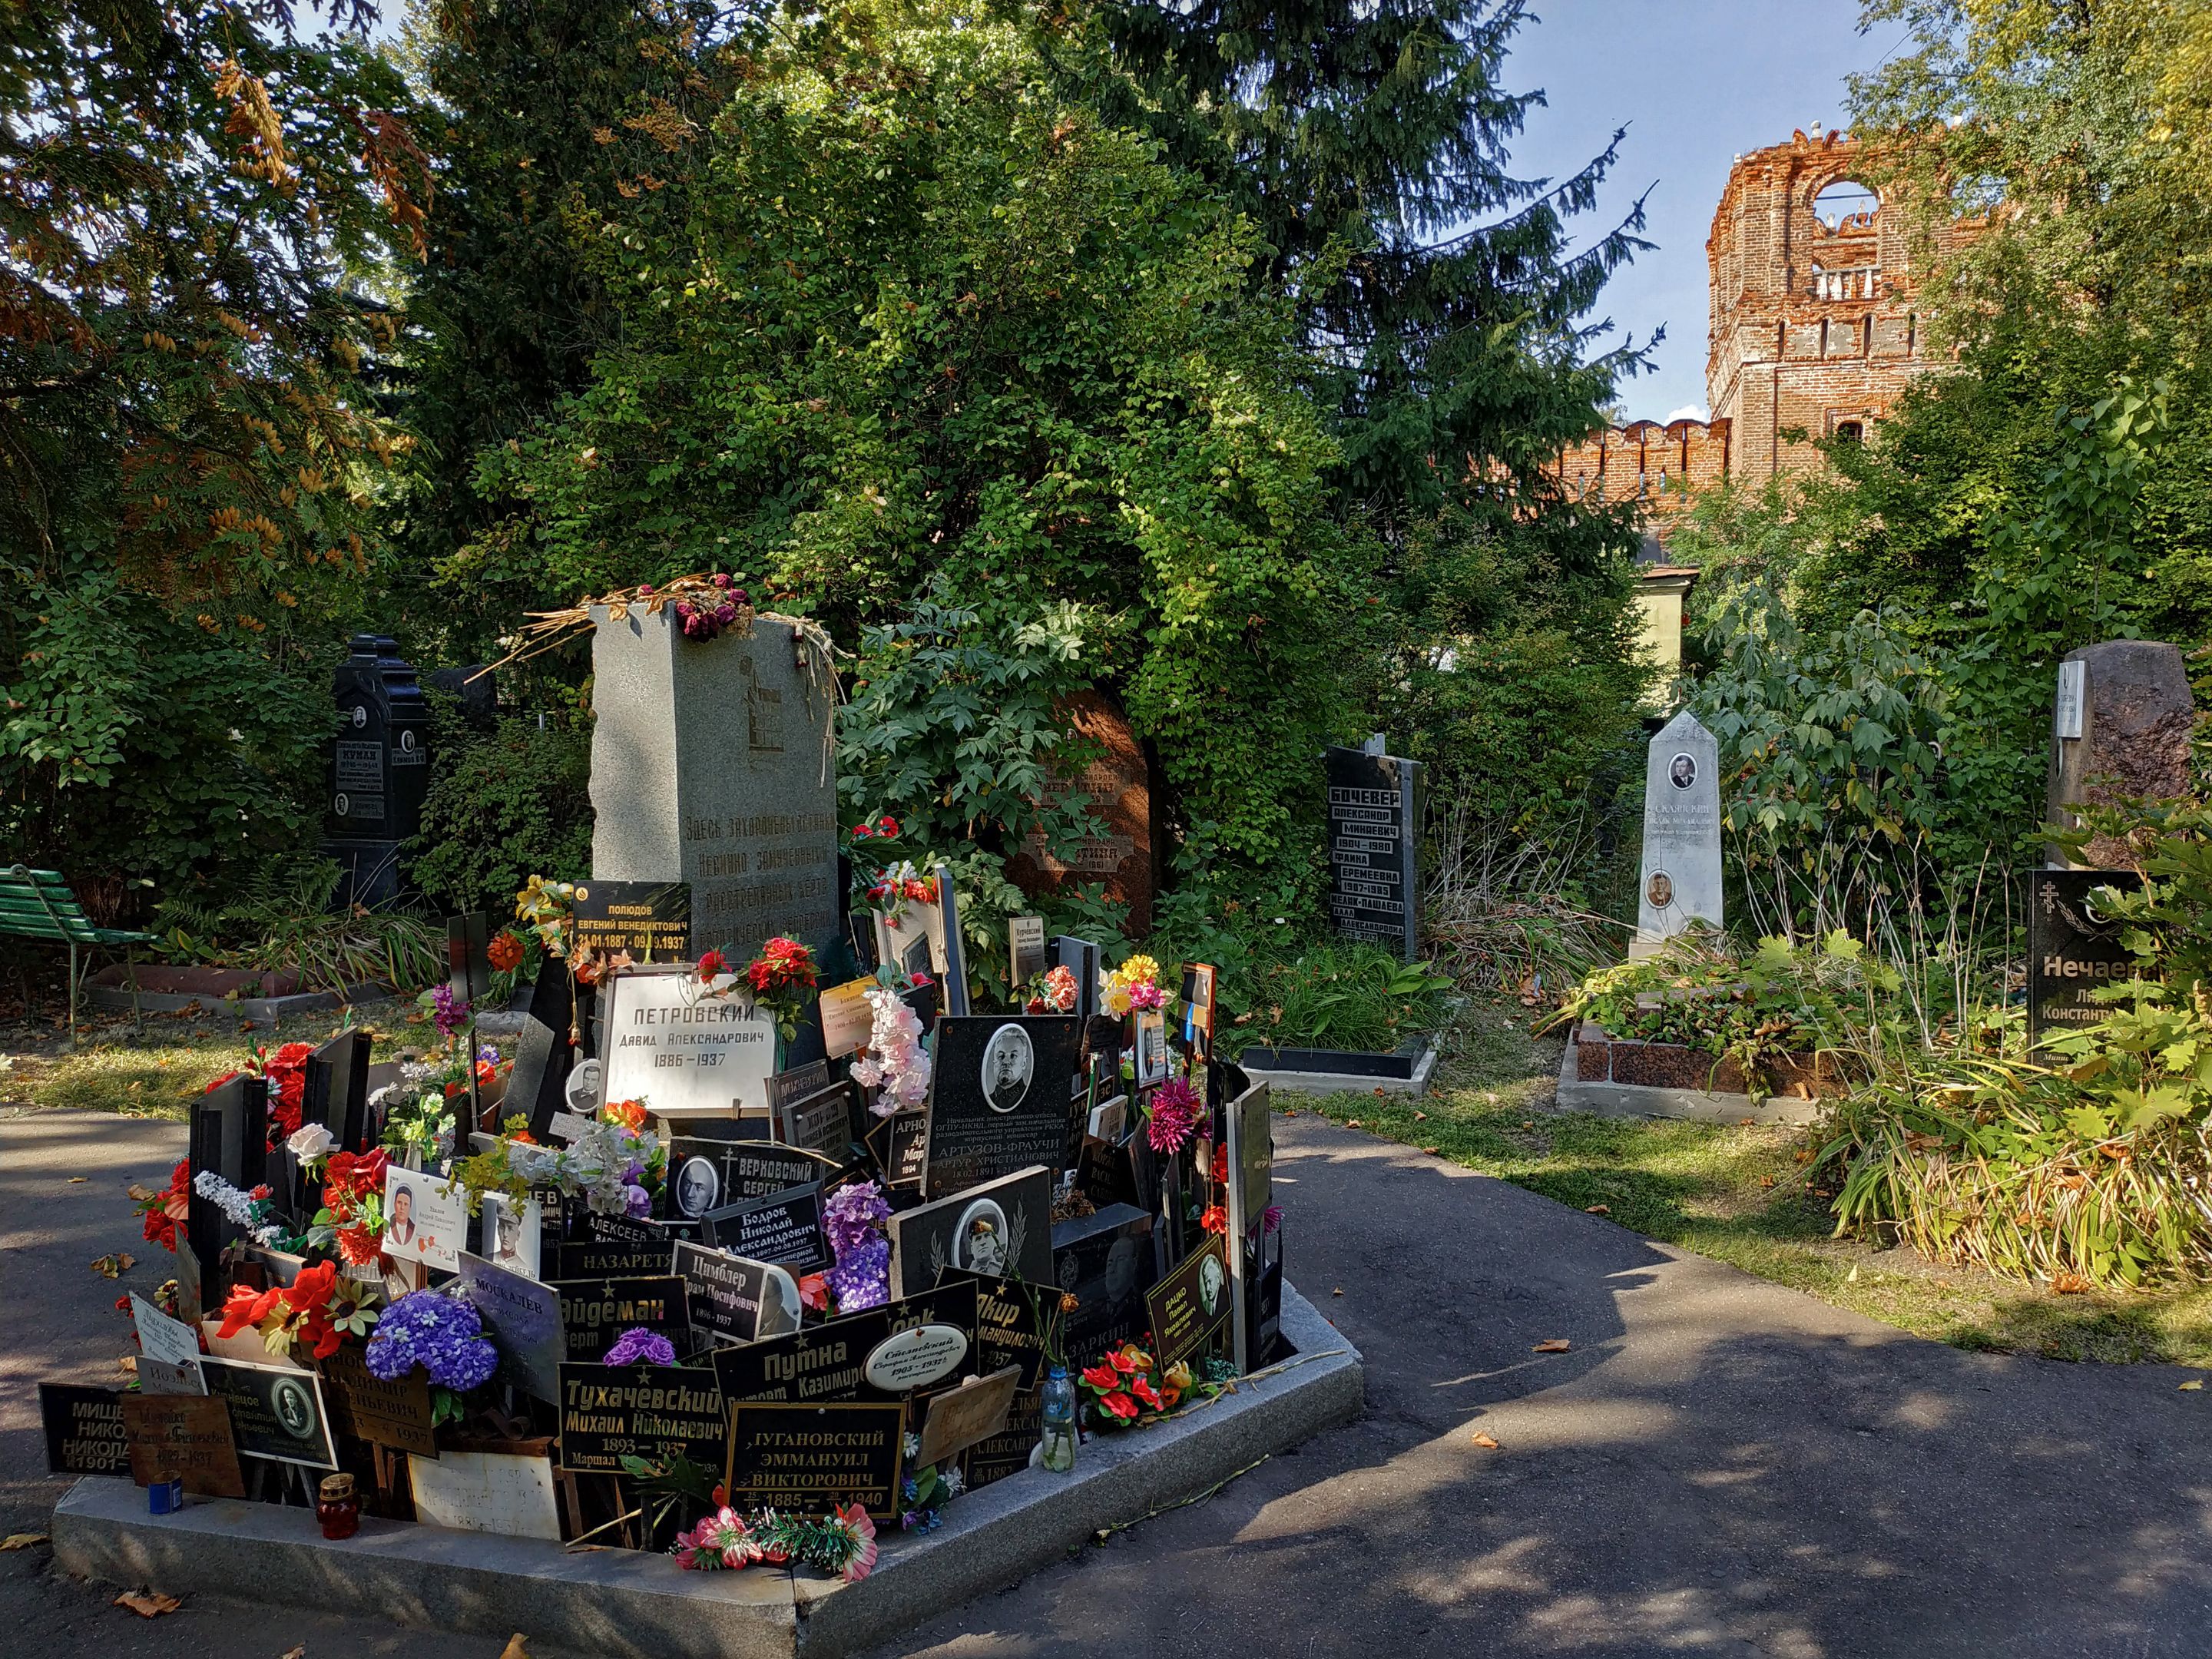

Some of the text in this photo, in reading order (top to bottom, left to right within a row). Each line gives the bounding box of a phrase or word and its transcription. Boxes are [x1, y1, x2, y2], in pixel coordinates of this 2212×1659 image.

[1330, 787, 1401, 806] БОЧЕВЕР
[1333, 807, 1390, 822] АЛЕКСАНДР
[1343, 823, 1397, 837] МИНАЕВИЧ
[1334, 852, 1367, 865] ФАИНА
[1343, 867, 1399, 882] ЕРЕМЕЕВНА
[1343, 882, 1389, 896] 1907-1985
[608, 905, 653, 917] ПОЛЮДОВ
[1330, 894, 1403, 912] МЕЛИК-ПАШАЕВА
[578, 919, 687, 932] ЕВГЕНИЙ ВЕНЕДИКТОВИЧ
[1341, 919, 1404, 935] АЛЕКСАНДРОВНА
[578, 934, 627, 948] 2101.1887
[634, 935, 685, 949] 09.9.1937
[619, 1031, 764, 1048] ДАВИД АЛЕКСАНДРОВИЧ
[938, 1138, 1061, 1158] АРТУЗОВ-ФРАУЧИ
[738, 1157, 813, 1183] ВЕРХОВСКИЙ
[902, 1164, 916, 1174] 1894
[936, 1151, 1060, 1170] АРТУР ХРИСТИАНОВИЧ
[743, 1181, 786, 1196] СЕРГЕЙ
[741, 1207, 788, 1227] Бодров
[588, 1216, 647, 1242] АЛЕКСЕЕВ
[740, 1217, 793, 1241] Николай
[725, 1224, 816, 1257] Александрович
[693, 1254, 747, 1291] Цимблер
[475, 1277, 543, 1315] МОСКАЛЕВ
[704, 1283, 759, 1313] Иосифович
[1164, 1286, 1187, 1313] ДАЦКО
[561, 1298, 664, 1327] Эйдеман
[696, 1306, 711, 1320] 1896
[716, 1313, 732, 1327] 1937
[1169, 1300, 1188, 1321] Павел
[1164, 1305, 1197, 1339] Яковлевич
[1068, 1321, 1131, 1359] ЗАРКИН
[763, 1340, 847, 1382] Путна
[890, 1365, 913, 1377] 1905
[566, 1378, 721, 1415] Тухачевский
[72, 1402, 124, 1422] МИЩЕ
[78, 1421, 127, 1440] НИКО
[565, 1410, 724, 1441] Михаил Николаевич
[602, 1438, 636, 1453] 1893
[655, 1441, 687, 1457] 1937
[571, 1452, 616, 1469] Маршал
[760, 1453, 869, 1467] ЭММАНУИЛ
[752, 1473, 874, 1488] ВИКТОРОВИЧ
[768, 1492, 802, 1507] 1885
[847, 1492, 882, 1506] 1940
